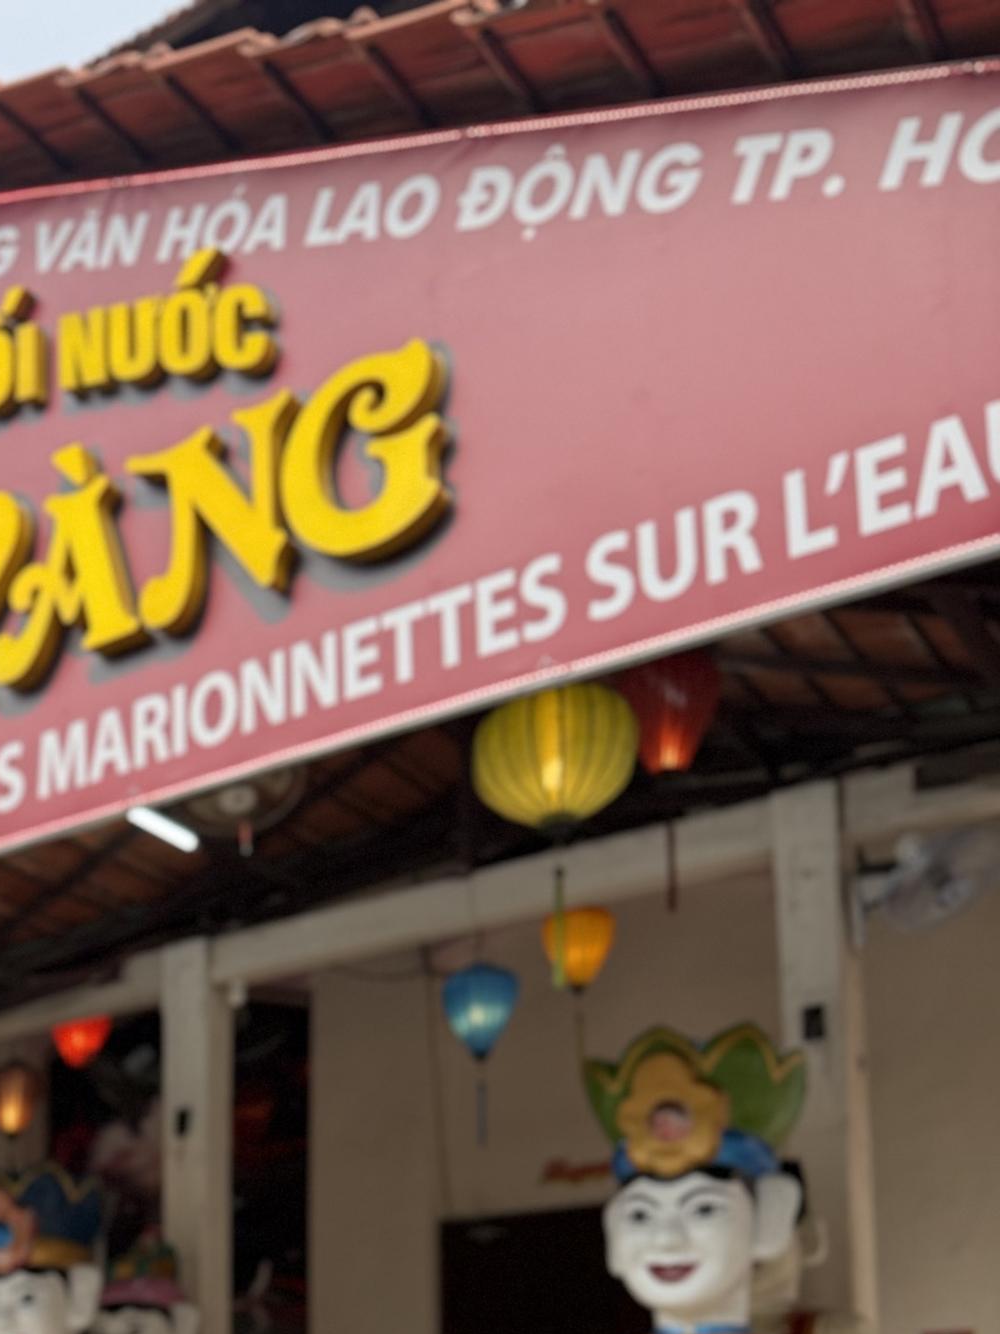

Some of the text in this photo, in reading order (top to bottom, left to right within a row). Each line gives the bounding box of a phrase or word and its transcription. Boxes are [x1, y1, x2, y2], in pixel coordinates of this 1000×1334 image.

[156, 183, 288, 263] HÓA
[303, 173, 440, 247] LAO
[455, 142, 703, 241] ĐỘNG
[731, 128, 845, 205] TP.
[36, 552, 567, 800] MARIONNETTES
[585, 489, 763, 623] SUR
[783, 399, 1000, 560] L'EA
